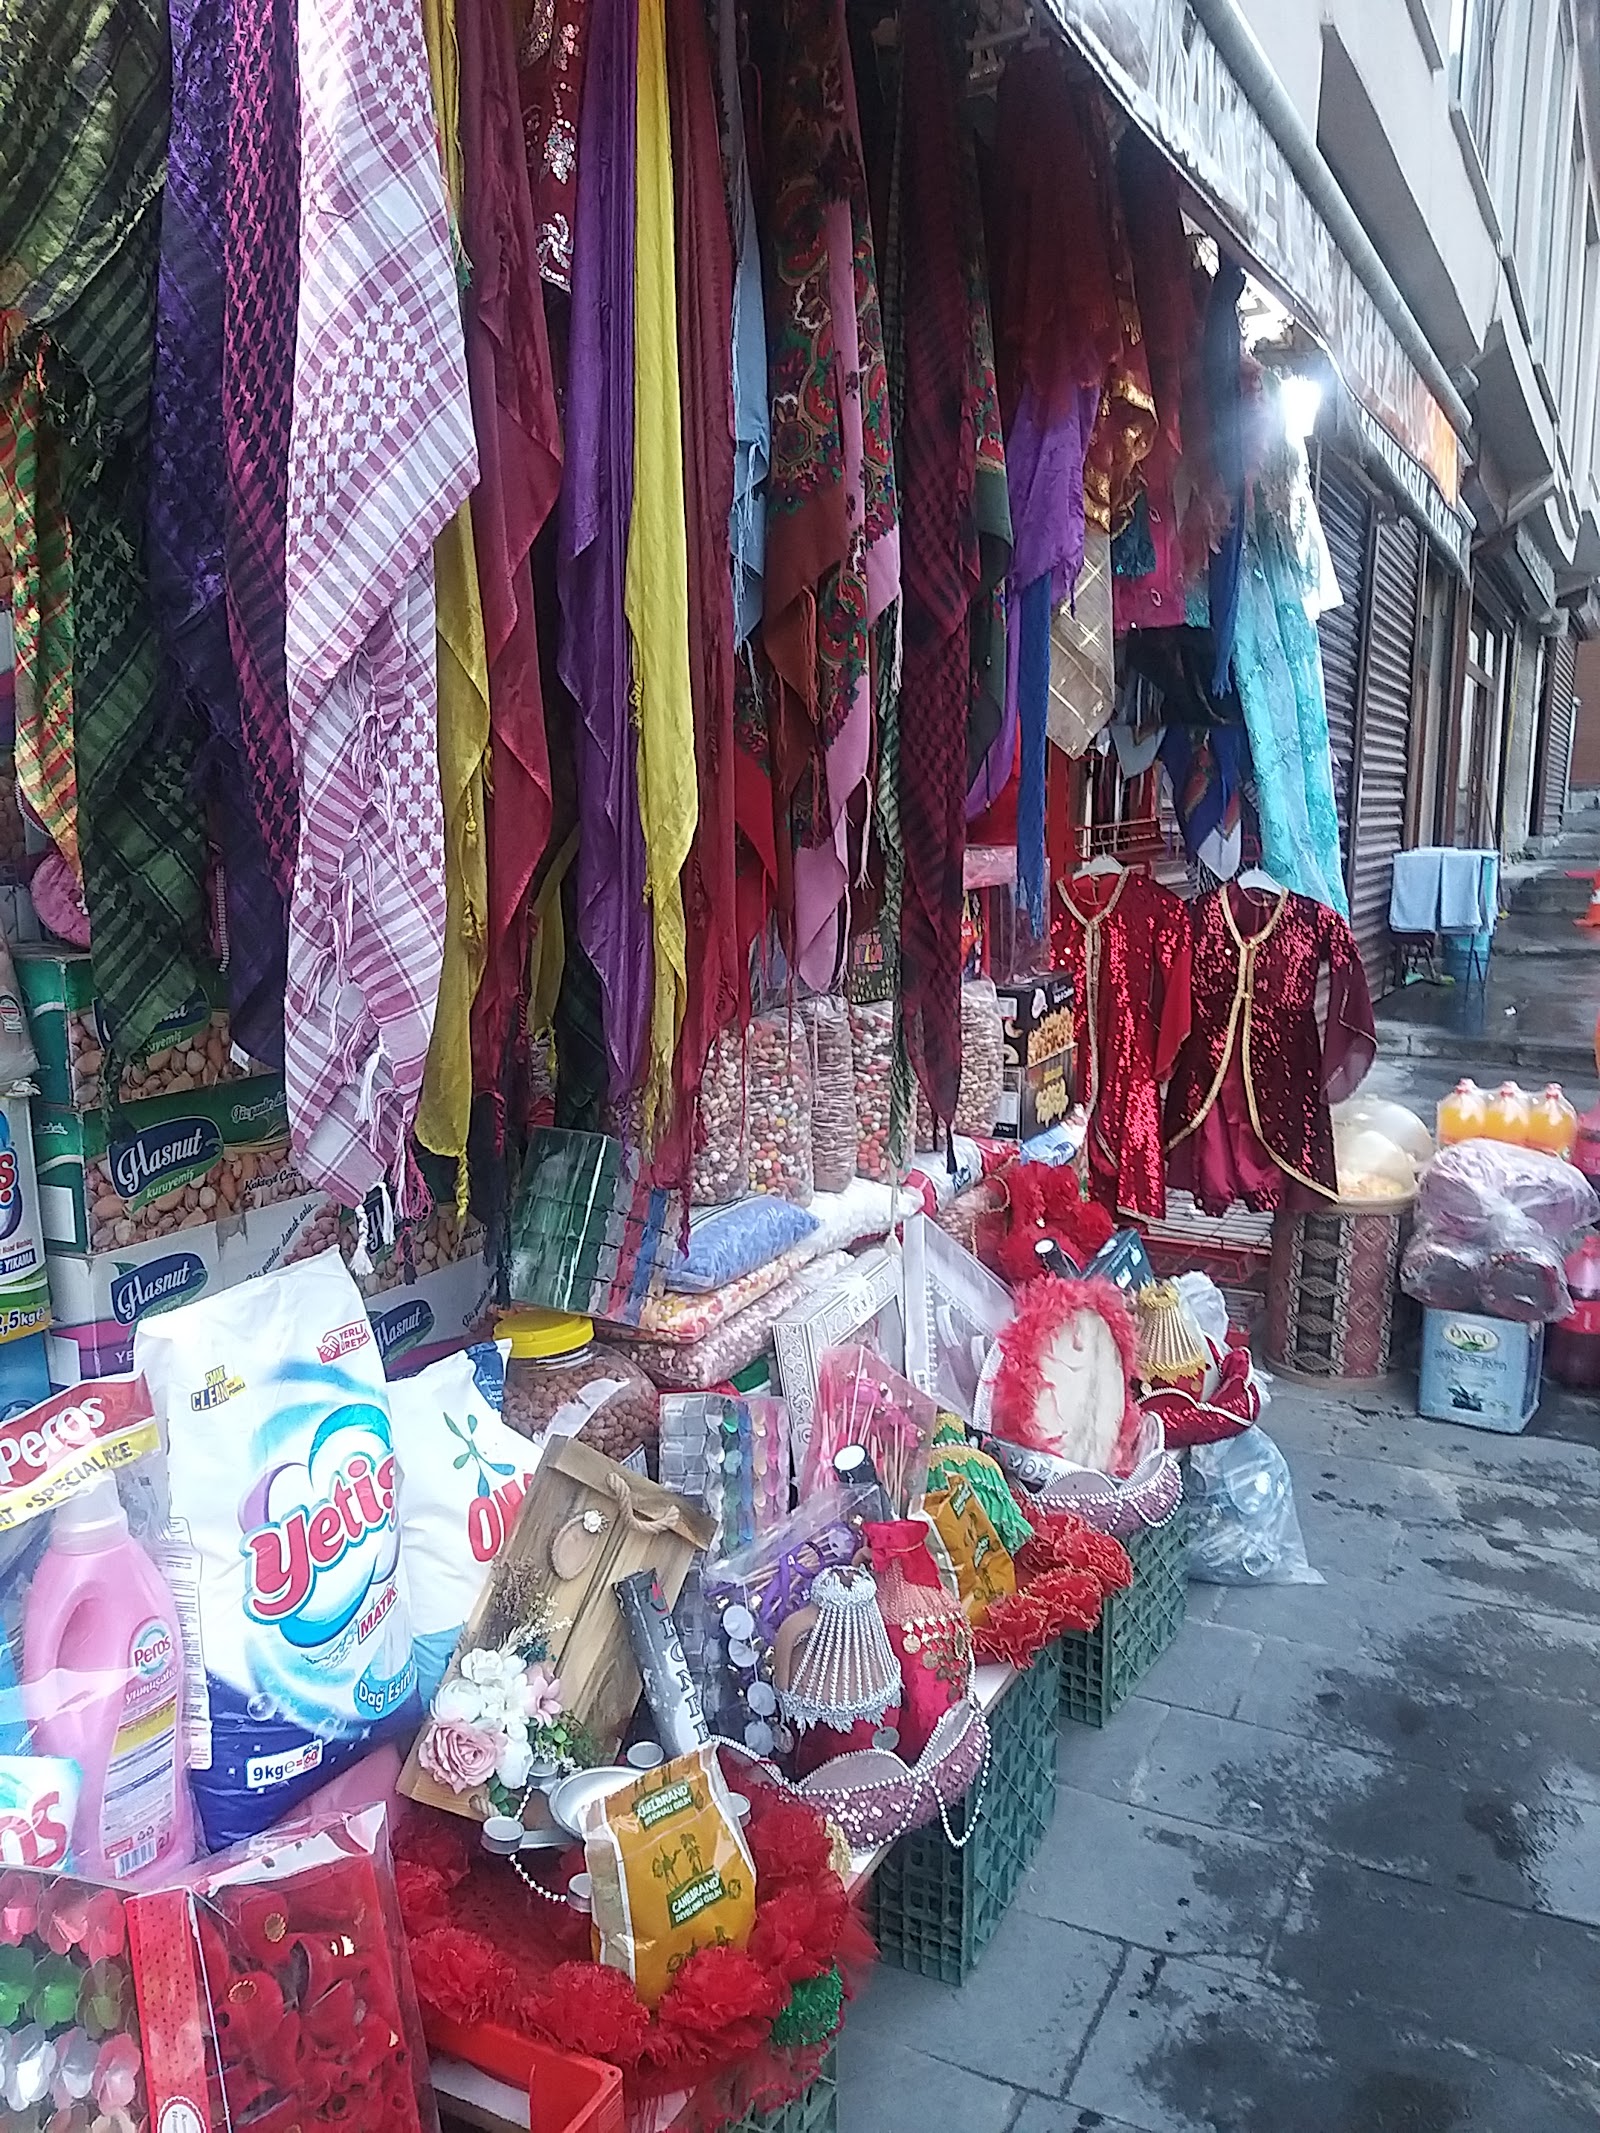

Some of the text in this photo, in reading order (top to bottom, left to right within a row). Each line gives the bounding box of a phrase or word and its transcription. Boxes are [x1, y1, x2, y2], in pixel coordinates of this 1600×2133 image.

[116, 1128, 203, 1194] Hasnut
[145, 1168, 195, 1201] kuruyemiş
[117, 1260, 191, 1321] Hasnut
[190, 1380, 230, 1412] CLEAN
[133, 1635, 172, 1667] Peros
[358, 1682, 384, 1713] Dağ
